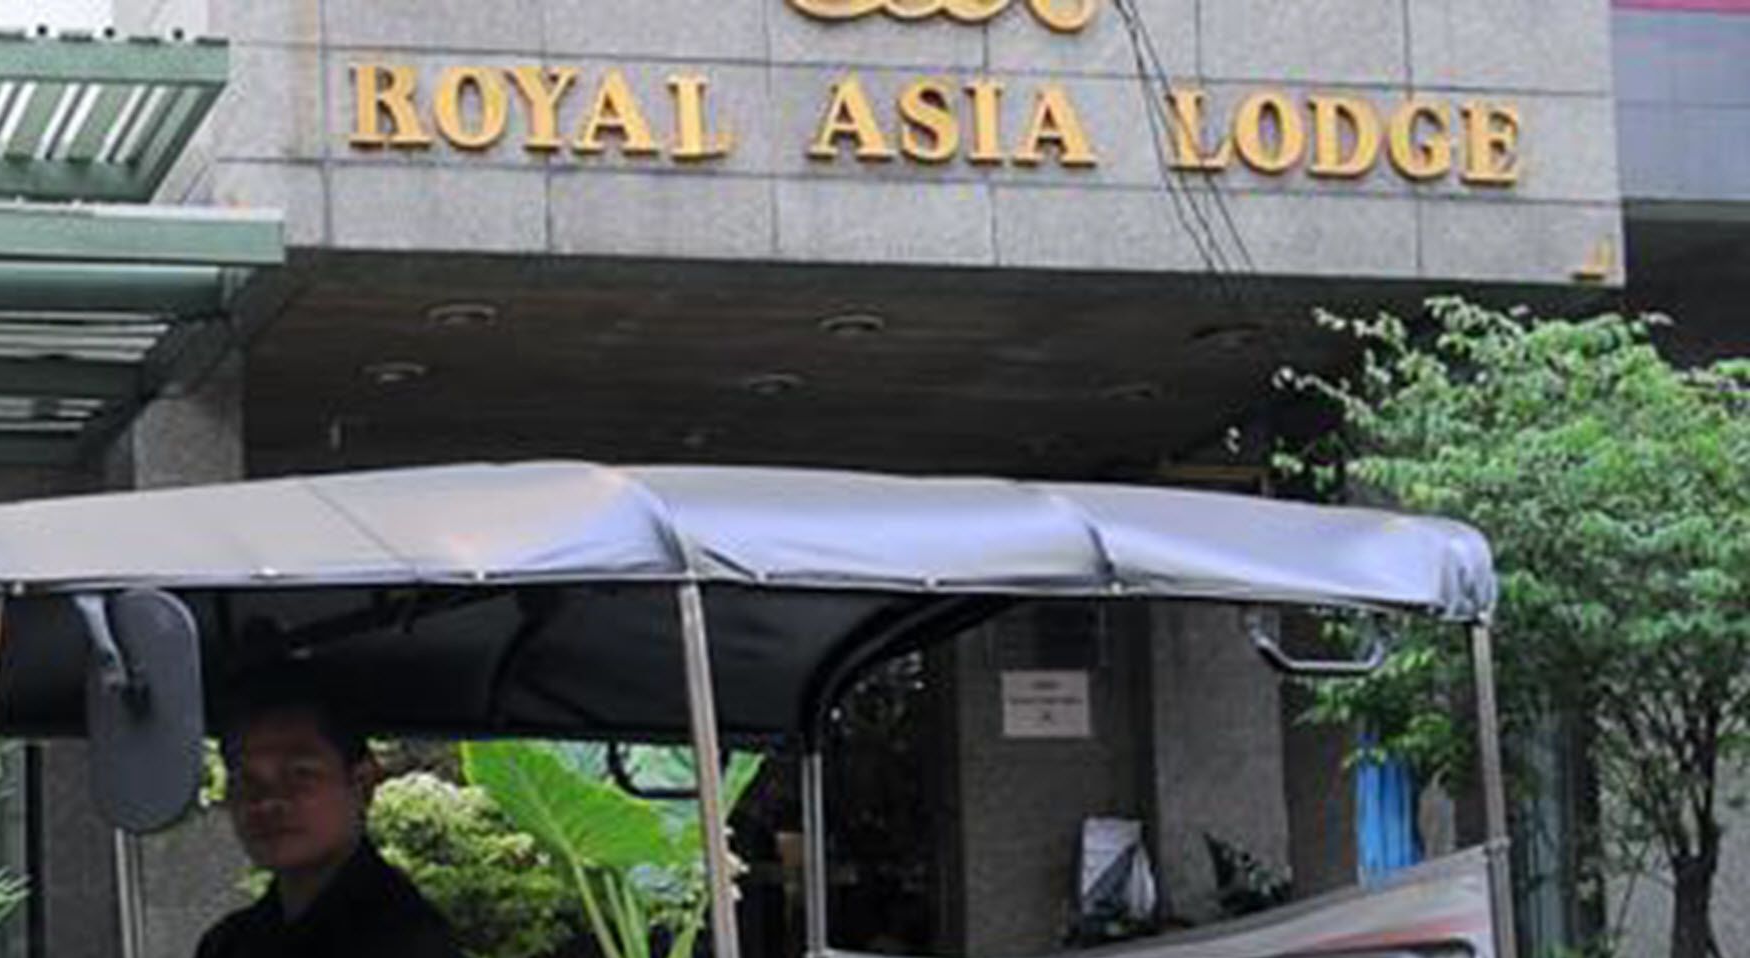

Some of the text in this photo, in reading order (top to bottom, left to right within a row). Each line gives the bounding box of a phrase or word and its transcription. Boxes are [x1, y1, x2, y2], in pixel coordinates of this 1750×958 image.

[348, 62, 1521, 185] ROYAL ASIA LODGE
